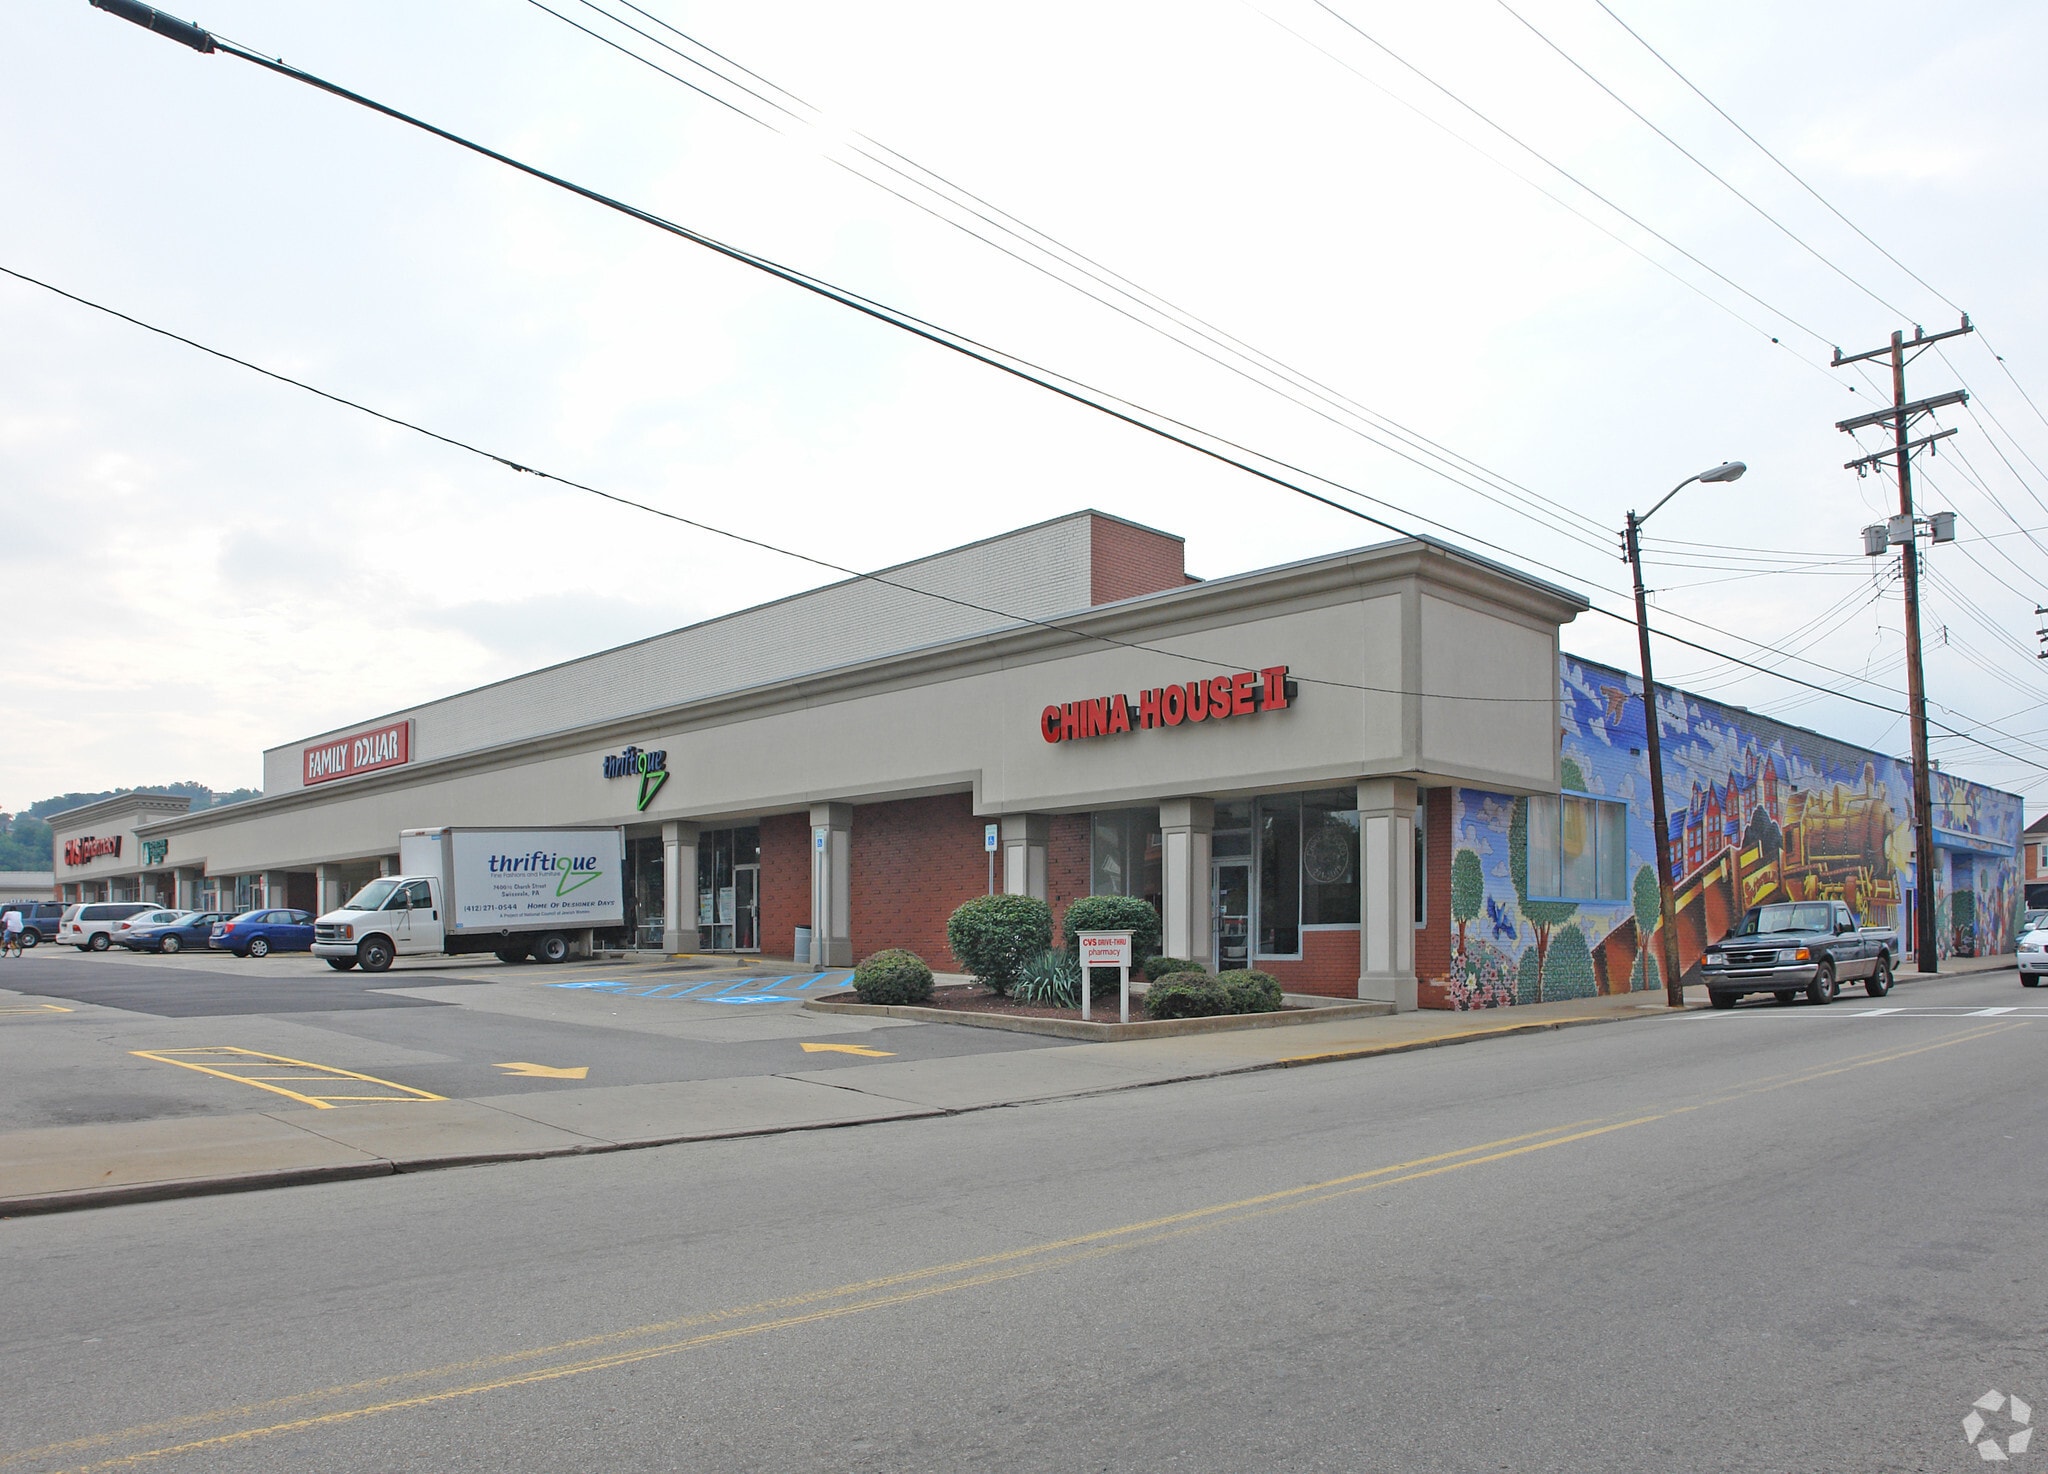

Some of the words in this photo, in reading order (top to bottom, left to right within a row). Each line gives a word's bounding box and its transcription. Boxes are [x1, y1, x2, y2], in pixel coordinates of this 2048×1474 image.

[1041, 693, 1131, 745] CHINA
[1140, 671, 1256, 730] HOUSE
[1261, 665, 1289, 712] II
[308, 743, 349, 779] FAMILY
[353, 730, 399, 769] DOLLAR
[1082, 938, 1097, 946] CVS
[1098, 938, 1127, 946] DRIVE-THRU
[1088, 948, 1121, 957] pharmacy
